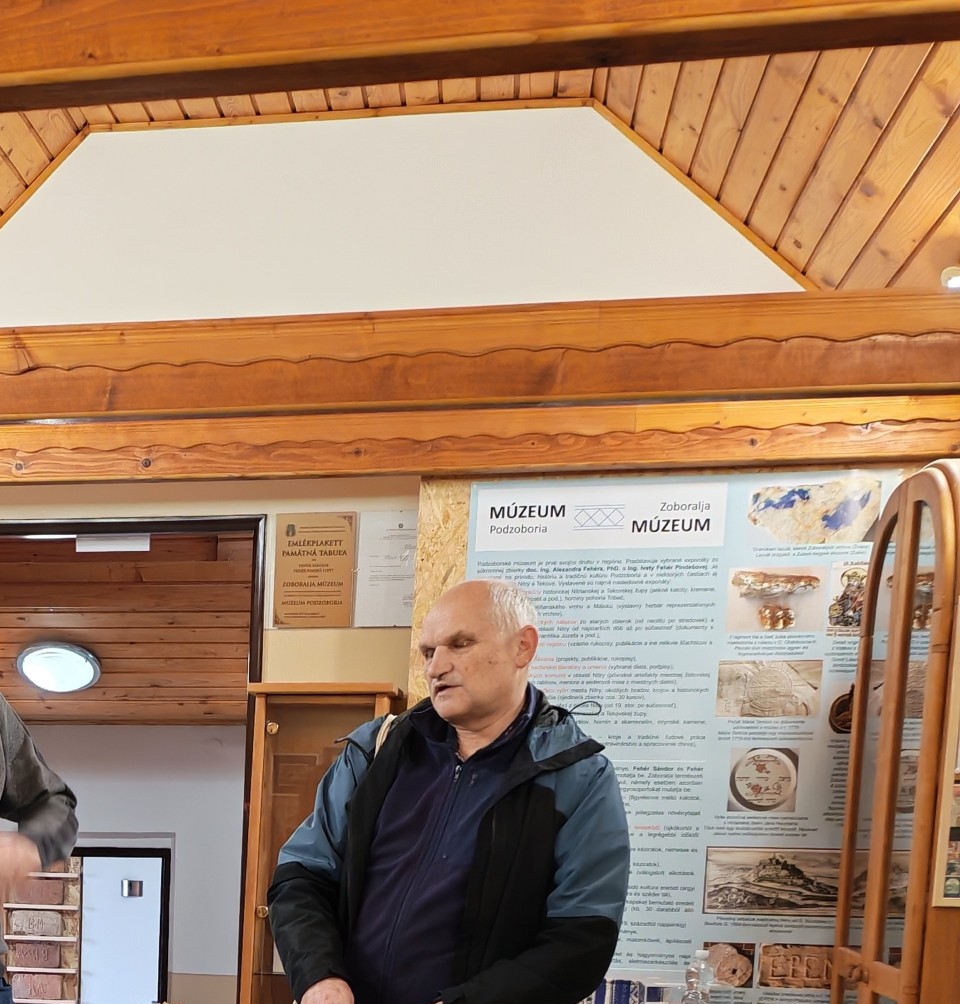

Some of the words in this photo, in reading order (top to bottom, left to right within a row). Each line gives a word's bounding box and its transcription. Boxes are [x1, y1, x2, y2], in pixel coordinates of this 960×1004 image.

[490, 502, 566, 519] MÚZEUM
[660, 501, 711, 512] Zoboralja
[490, 524, 548, 534] Podzoboria
[631, 516, 711, 533] MÚZEUM
